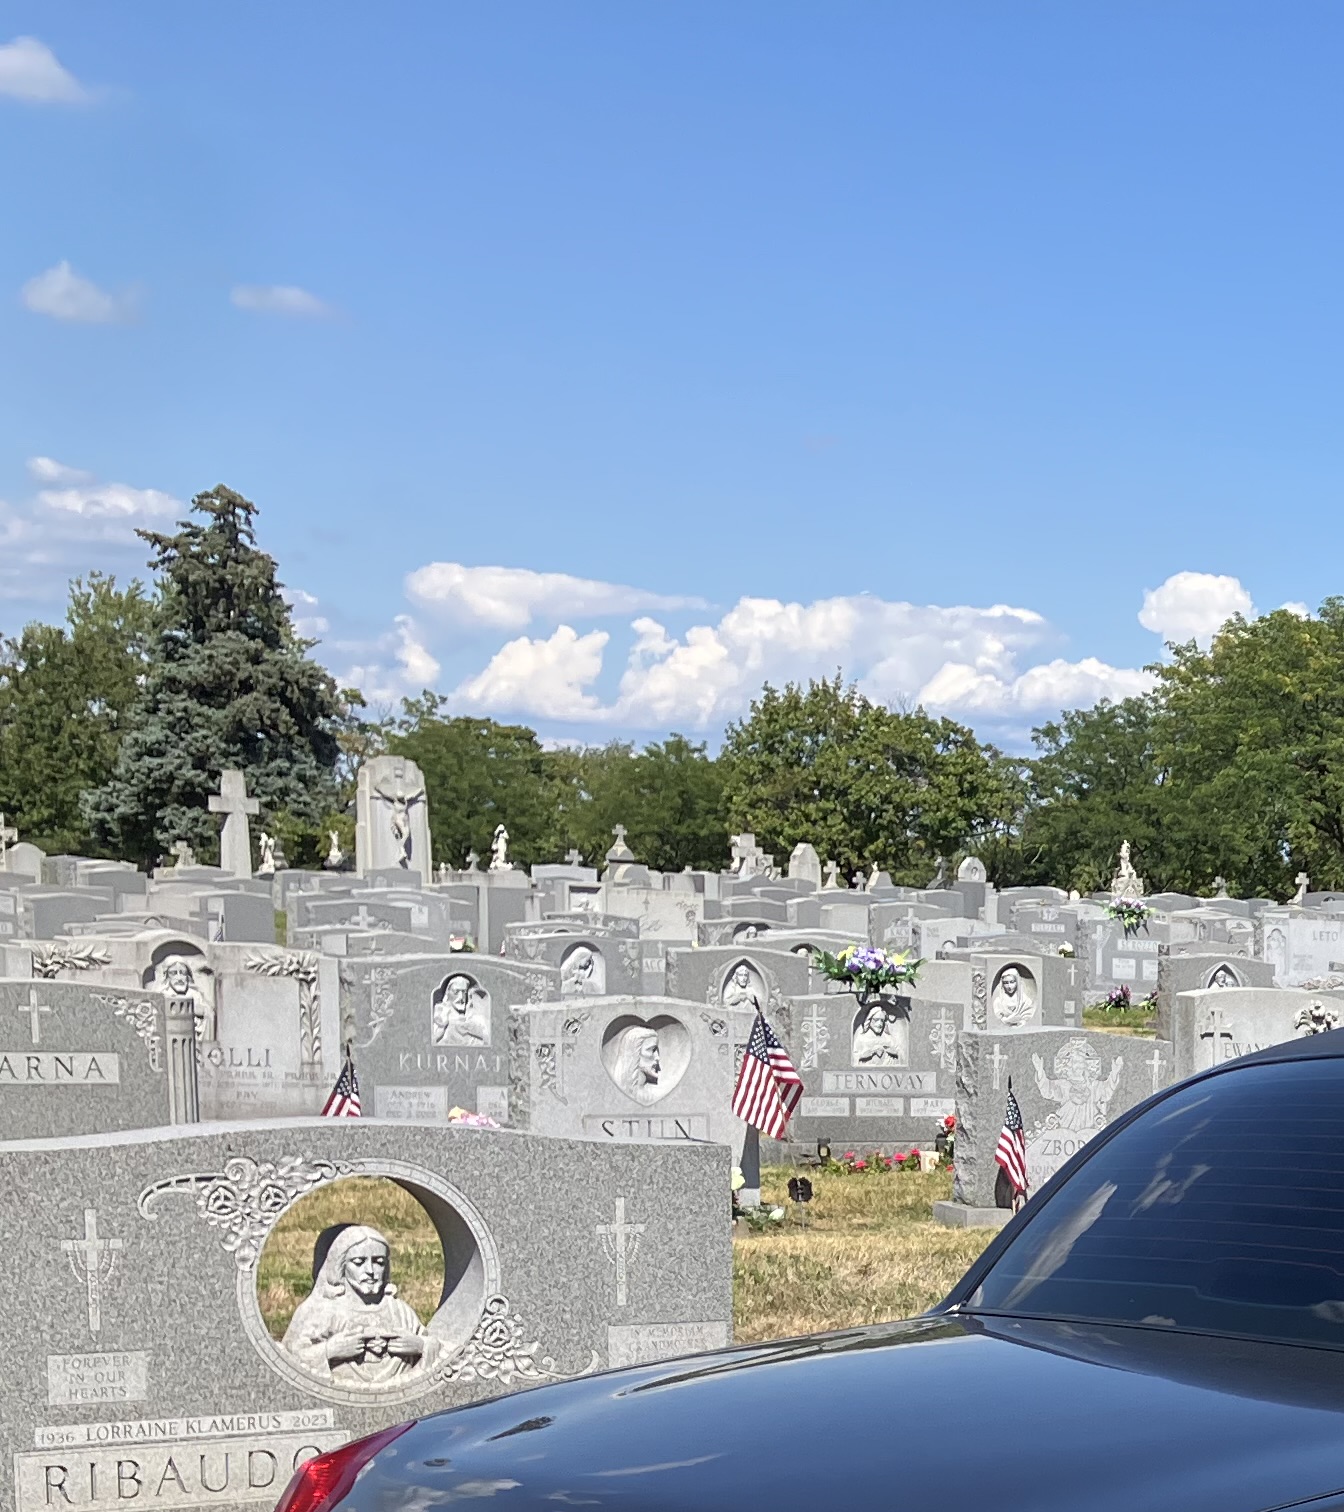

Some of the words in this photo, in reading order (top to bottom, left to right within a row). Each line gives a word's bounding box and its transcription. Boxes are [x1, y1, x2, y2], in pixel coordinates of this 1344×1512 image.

[1312, 930, 1339, 942] LETO
[833, 1073, 927, 1090] TERNOVAY
[62, 1355, 131, 1370] FOREVER
[69, 1373, 85, 1384] IN
[94, 1370, 125, 1383] OUR
[69, 1386, 127, 1399] HEARTS
[40, 1431, 76, 1444] 1936
[86, 1420, 179, 1442] LORRAINE
[186, 1414, 282, 1435] KLAMERUS
[292, 1414, 329, 1427] 2023
